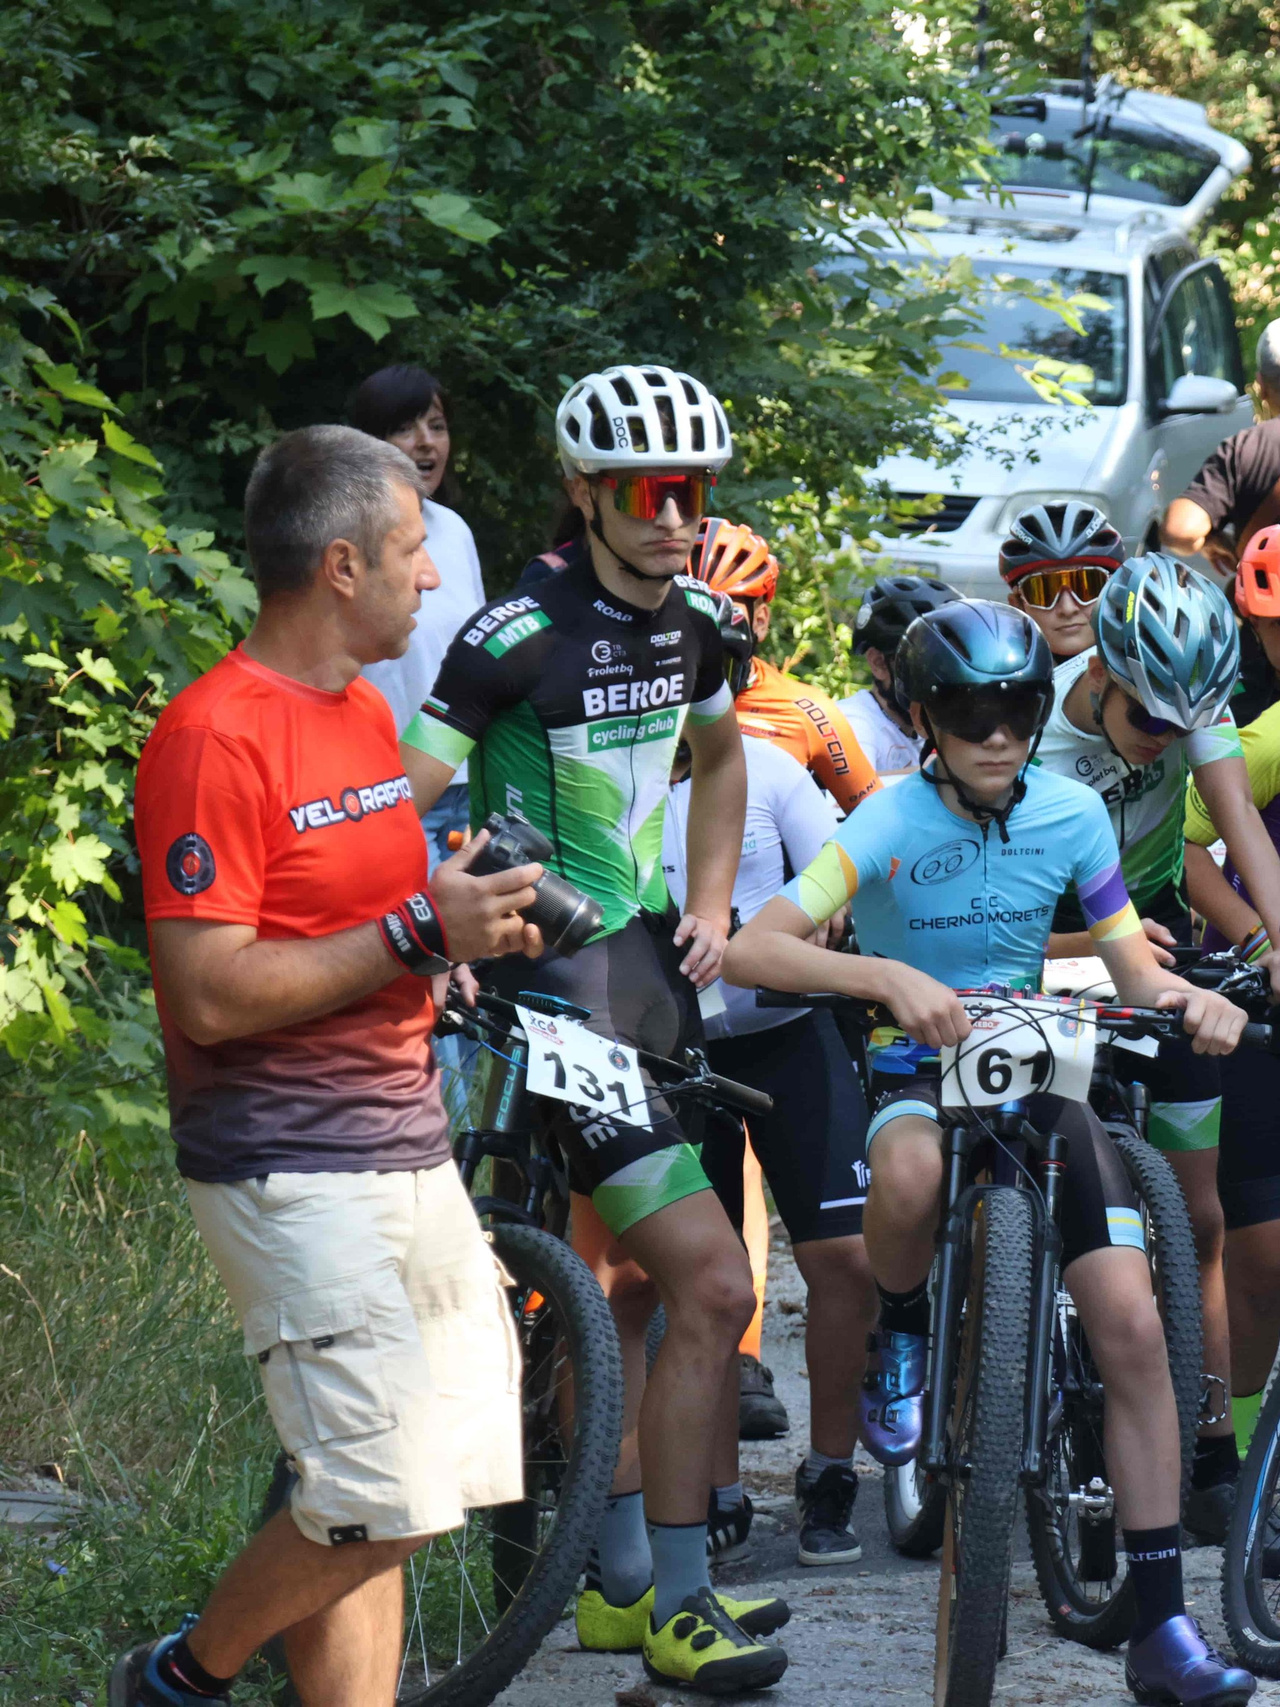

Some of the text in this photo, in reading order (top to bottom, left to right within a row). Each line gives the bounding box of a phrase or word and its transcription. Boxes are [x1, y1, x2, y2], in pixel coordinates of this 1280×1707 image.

[463, 595, 541, 647] BEROE
[593, 599, 633, 622] ROAD
[689, 592, 719, 622] ROA
[496, 615, 541, 647] MTB
[582, 673, 685, 717] BEROE
[592, 715, 674, 746] cycling club
[795, 698, 850, 776] DOLTCINI
[1001, 848, 1045, 856] DOLTCINI
[386, 913, 412, 952] anon
[495, 1048, 521, 1129] FOCUS
[544, 1051, 632, 1117] 131
[977, 1047, 1050, 1095] 61
